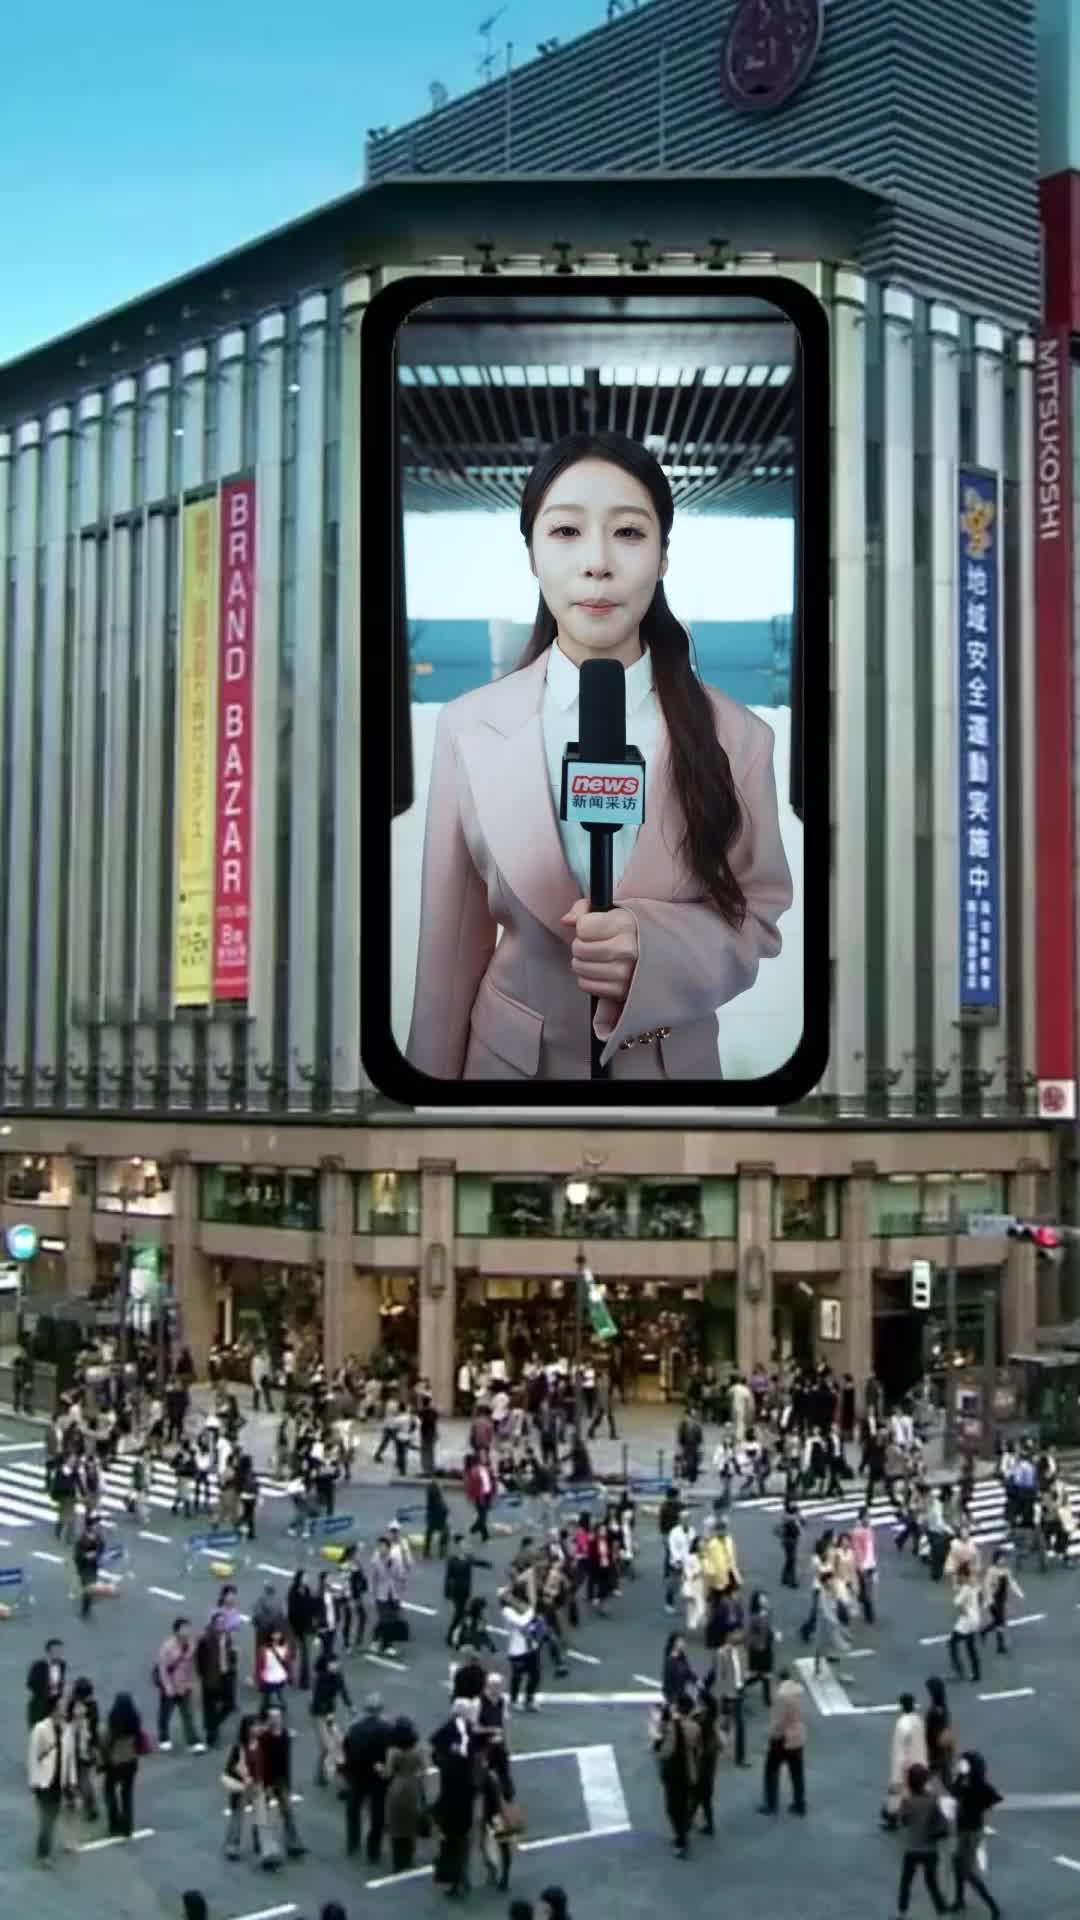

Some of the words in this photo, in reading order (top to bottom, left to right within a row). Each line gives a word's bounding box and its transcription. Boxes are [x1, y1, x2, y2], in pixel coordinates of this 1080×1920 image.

[1038, 338, 1061, 539] MITSUKOSHI
[225, 492, 249, 682] BRAND
[222, 704, 244, 893] BAZAR
[572, 775, 639, 795] news
[572, 794, 637, 810] 新闻采访
